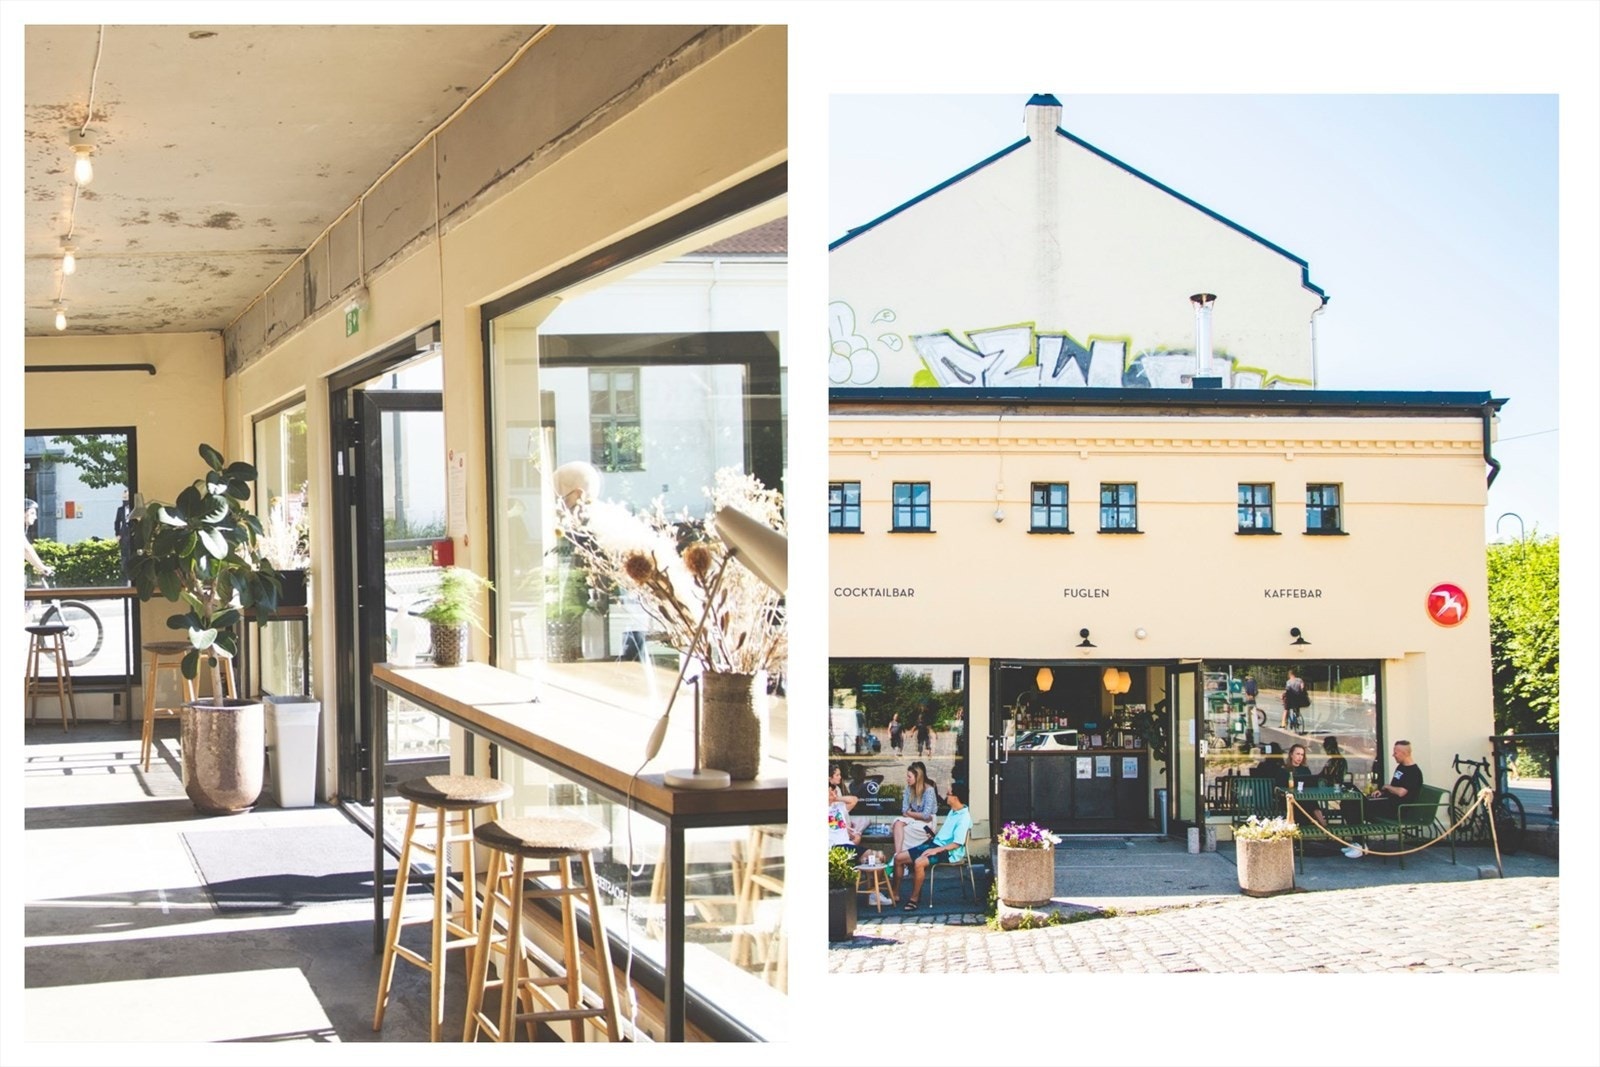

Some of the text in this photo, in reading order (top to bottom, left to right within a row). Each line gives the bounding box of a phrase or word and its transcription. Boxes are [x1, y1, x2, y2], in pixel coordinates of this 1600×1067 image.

[833, 587, 915, 598] COCKTAILBAR
[1063, 588, 1110, 599] FUGLEN
[1264, 588, 1323, 599] KAFFEBAR
